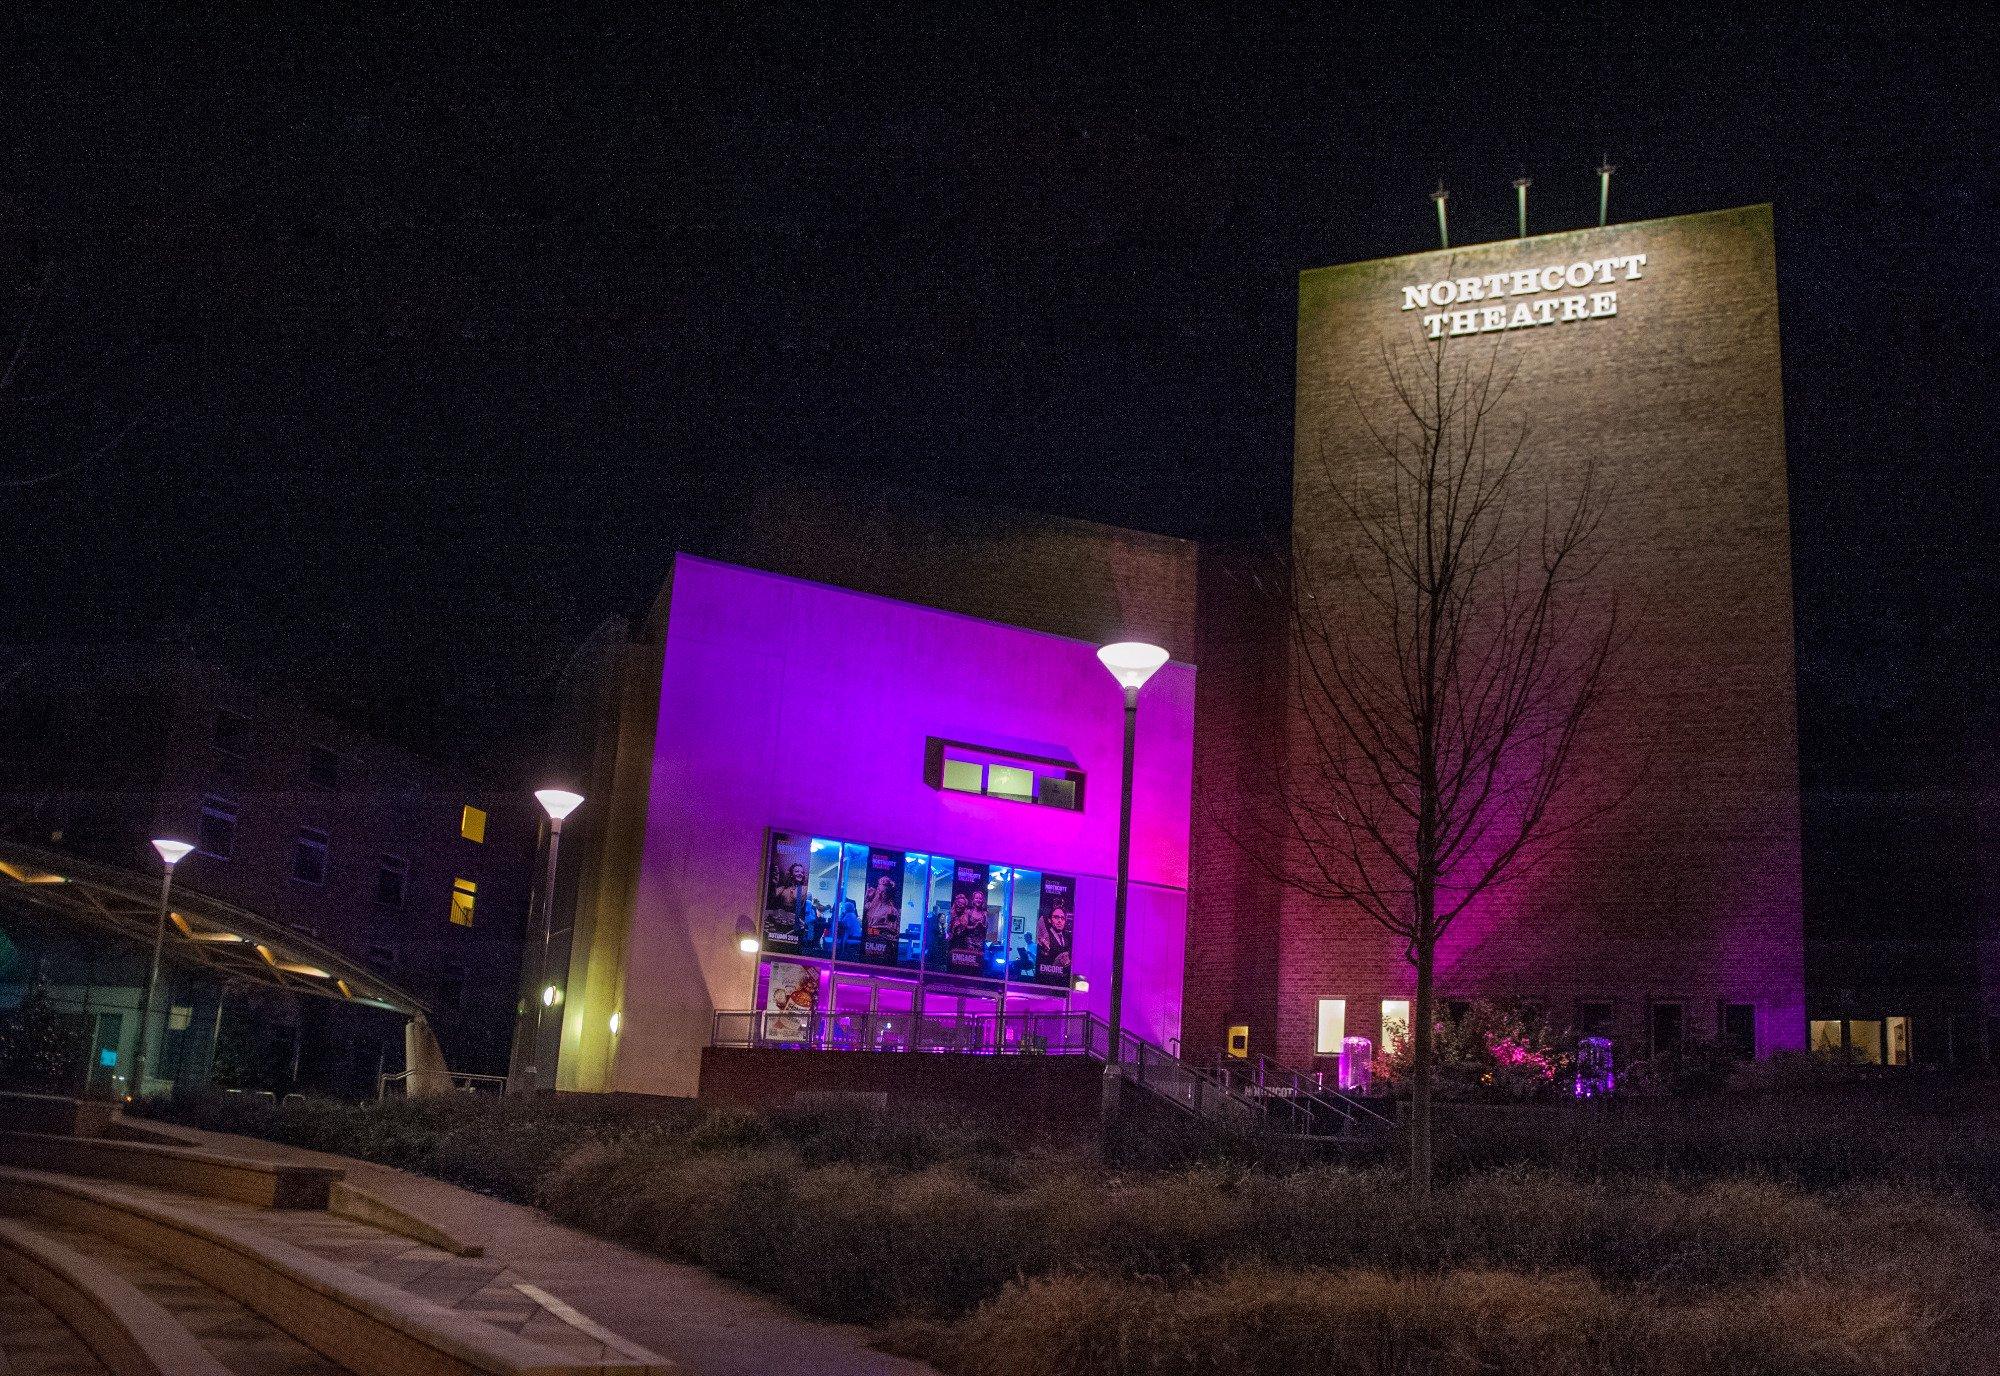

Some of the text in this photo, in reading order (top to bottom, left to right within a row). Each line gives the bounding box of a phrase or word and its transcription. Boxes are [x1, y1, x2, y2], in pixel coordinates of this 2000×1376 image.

[1401, 253, 1647, 311] NORTHCOTT
[1423, 290, 1617, 339] THEATRE
[865, 942, 887, 951] ENJOY
[952, 953, 977, 963] ENGAGE
[1040, 964, 1064, 974] ENCORE
